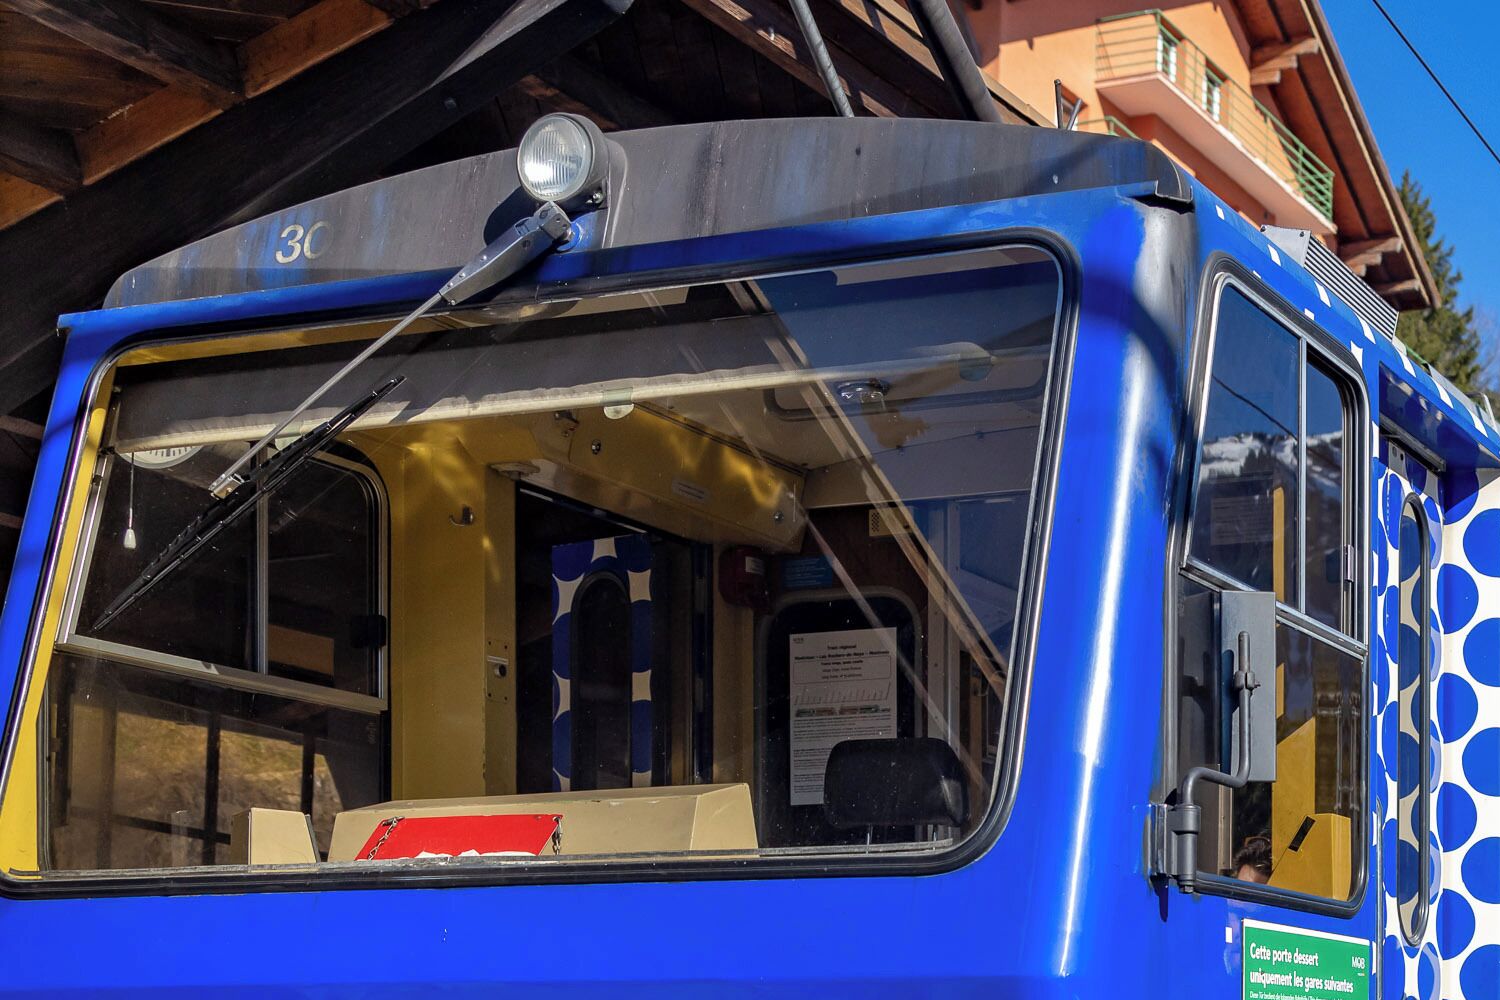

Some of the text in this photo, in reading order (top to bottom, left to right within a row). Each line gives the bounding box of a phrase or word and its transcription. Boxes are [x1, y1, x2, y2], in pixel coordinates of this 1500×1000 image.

[1250, 943, 1319, 966] Cette porte dessert
[1250, 968, 1354, 993] uniquement les gares suivantes
